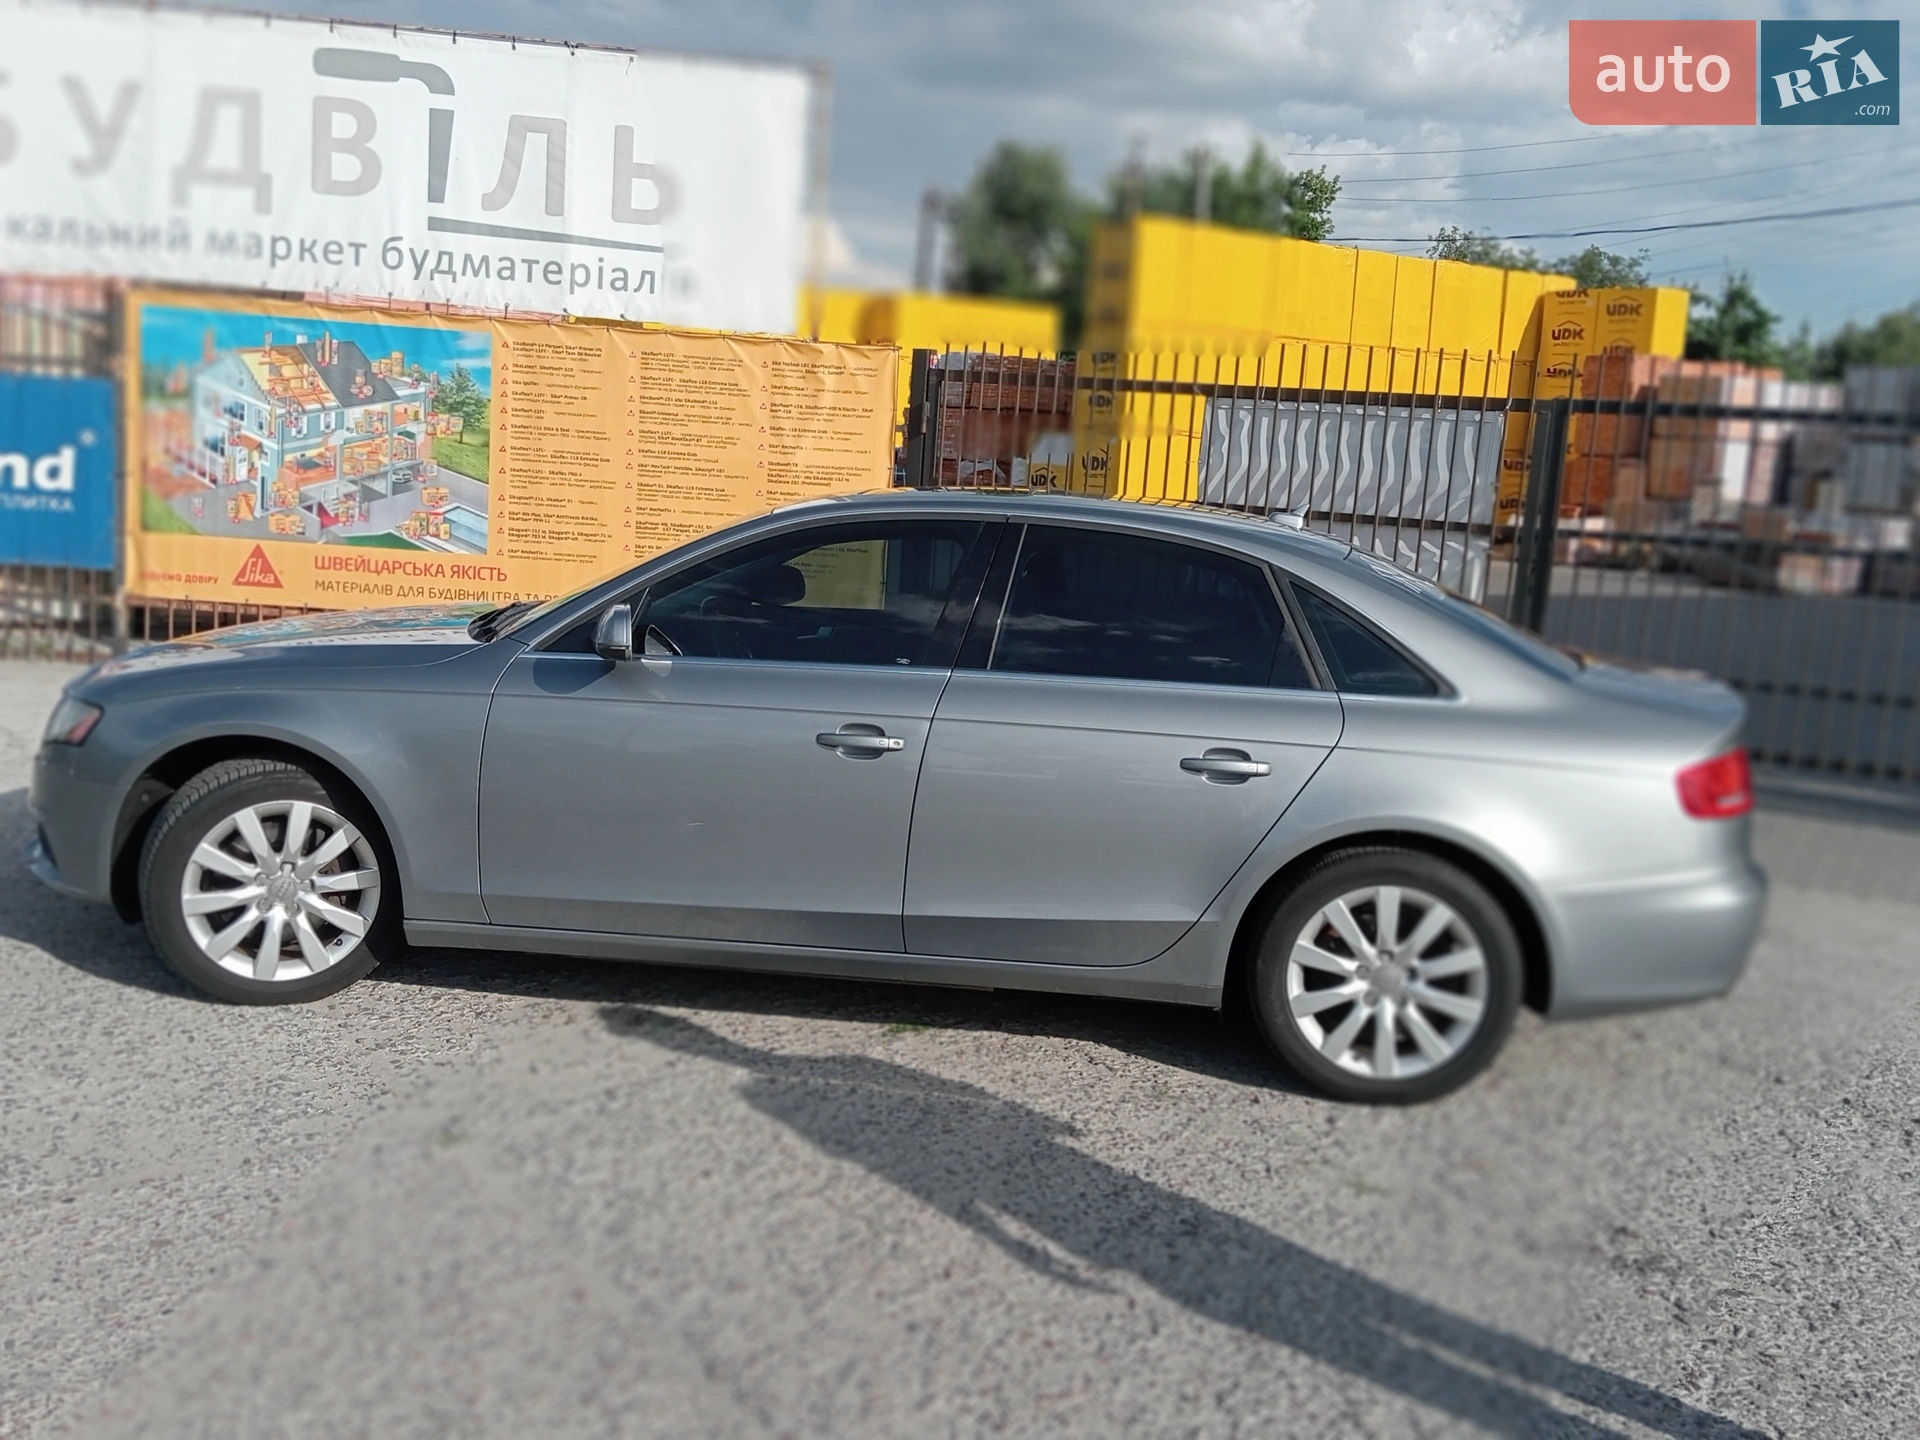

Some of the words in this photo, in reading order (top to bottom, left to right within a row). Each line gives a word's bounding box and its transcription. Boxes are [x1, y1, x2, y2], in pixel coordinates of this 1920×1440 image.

[203, 228, 367, 268] маркет
[1606, 304, 1643, 316] UDK
[1552, 328, 1585, 340] UDK
[1031, 474, 1057, 488] UDK
[238, 557, 275, 584] Sika
[314, 556, 446, 579] ШВЕЙЦАРСЬКА
[450, 564, 508, 582] ЯКІСТЬ
[184, 574, 219, 585] ДОВІРУ
[315, 580, 393, 596] МАТЕРІАЛІВ
[397, 586, 425, 598] ДЛЯ
